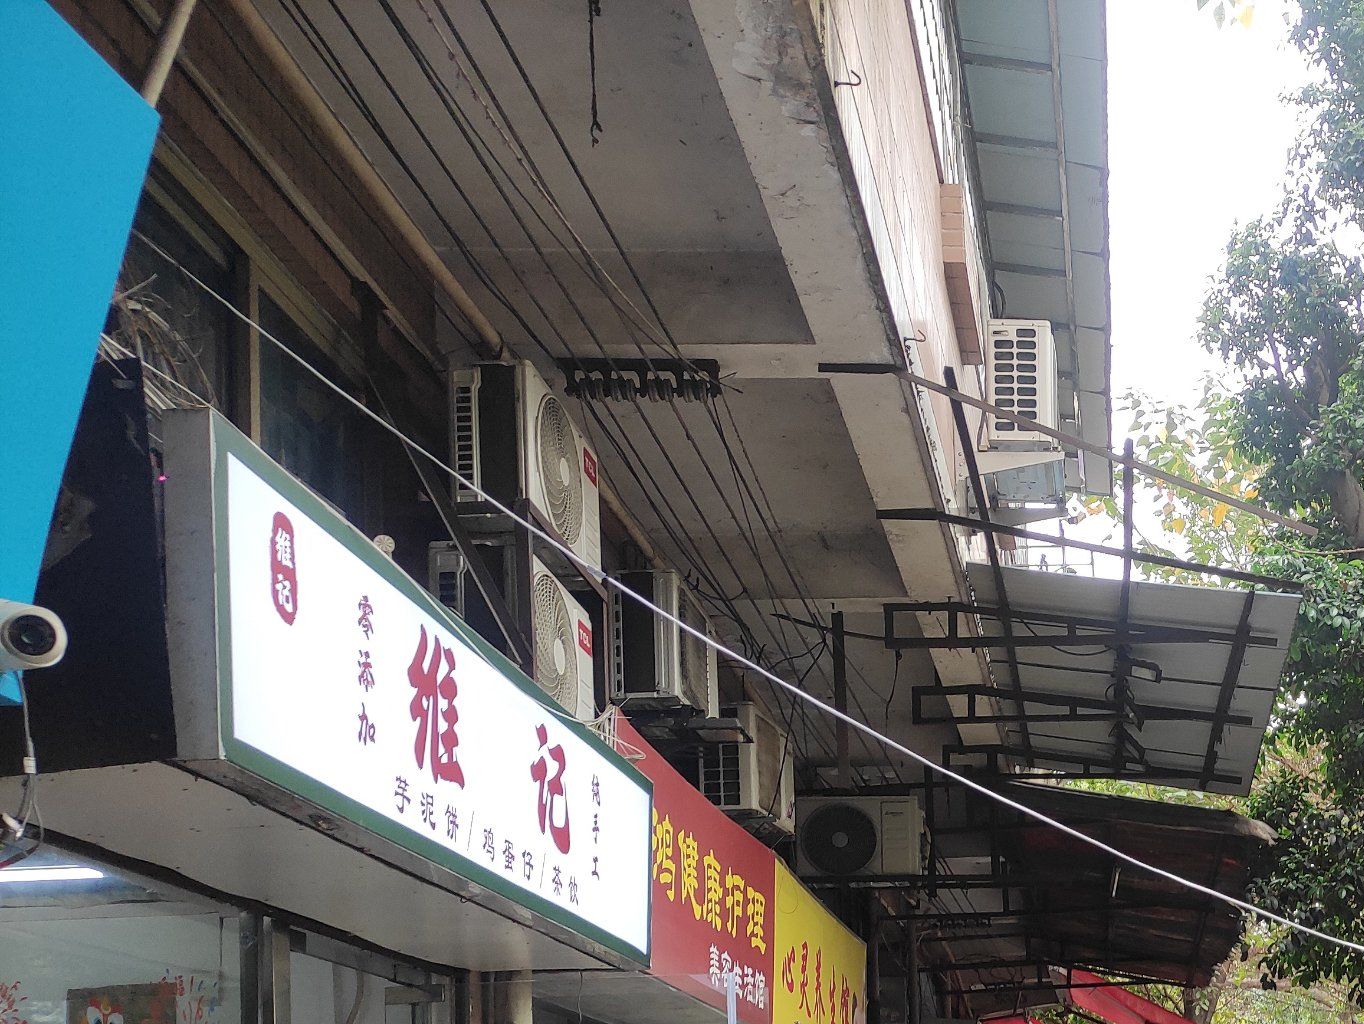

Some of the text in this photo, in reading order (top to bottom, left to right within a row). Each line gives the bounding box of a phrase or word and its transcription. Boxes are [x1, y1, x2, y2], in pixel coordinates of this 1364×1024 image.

[584, 454, 596, 477] TCL
[274, 527, 294, 614] 维记
[357, 595, 376, 746] 零添加
[579, 630, 591, 649] TCL
[407, 624, 570, 854] 维记
[590, 773, 601, 881] 纯手工
[709, 942, 766, 1010] 美容生活馆
